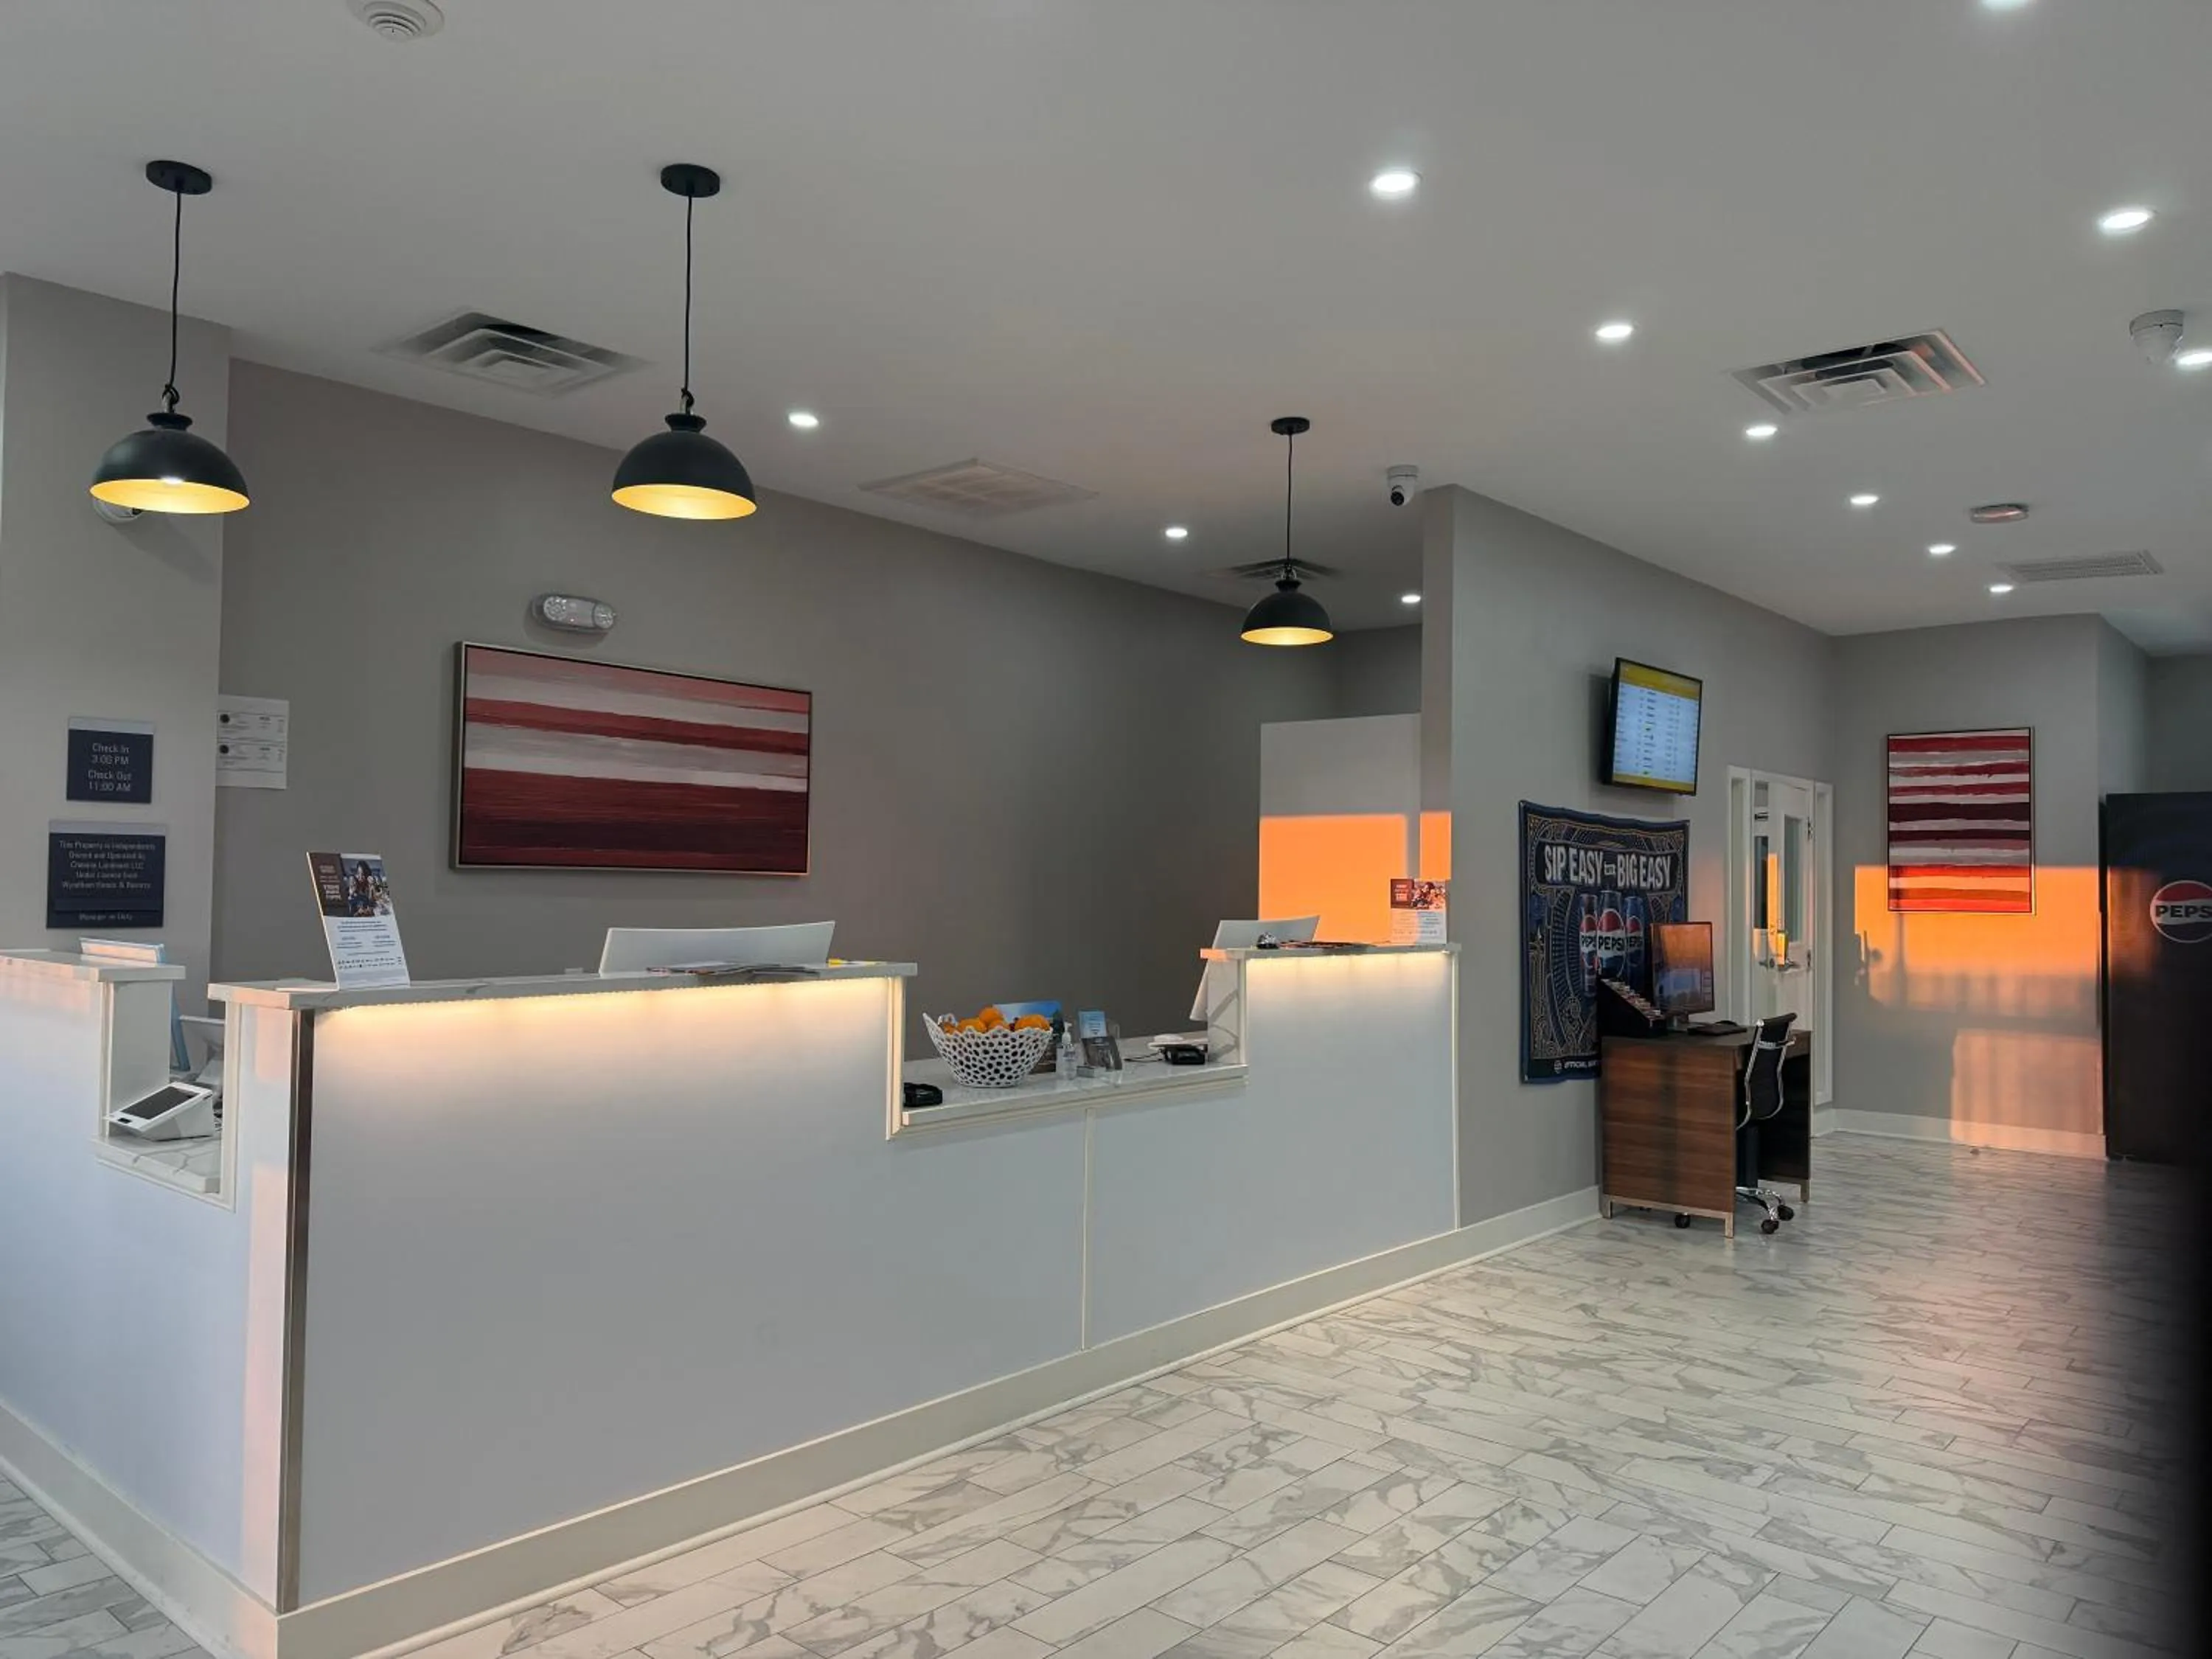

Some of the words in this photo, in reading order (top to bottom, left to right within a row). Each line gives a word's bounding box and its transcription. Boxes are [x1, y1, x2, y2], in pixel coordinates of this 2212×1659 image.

[91, 742, 119, 753] Check
[114, 756, 129, 765] PM
[88, 770, 113, 779] Check
[116, 771, 132, 780] Out
[88, 781, 114, 791] 11:00
[116, 782, 131, 792] AM
[1544, 844, 1566, 882] SIP
[1568, 847, 1604, 886] EASY
[1617, 853, 1638, 888] BIG
[1639, 855, 1671, 889] EASY
